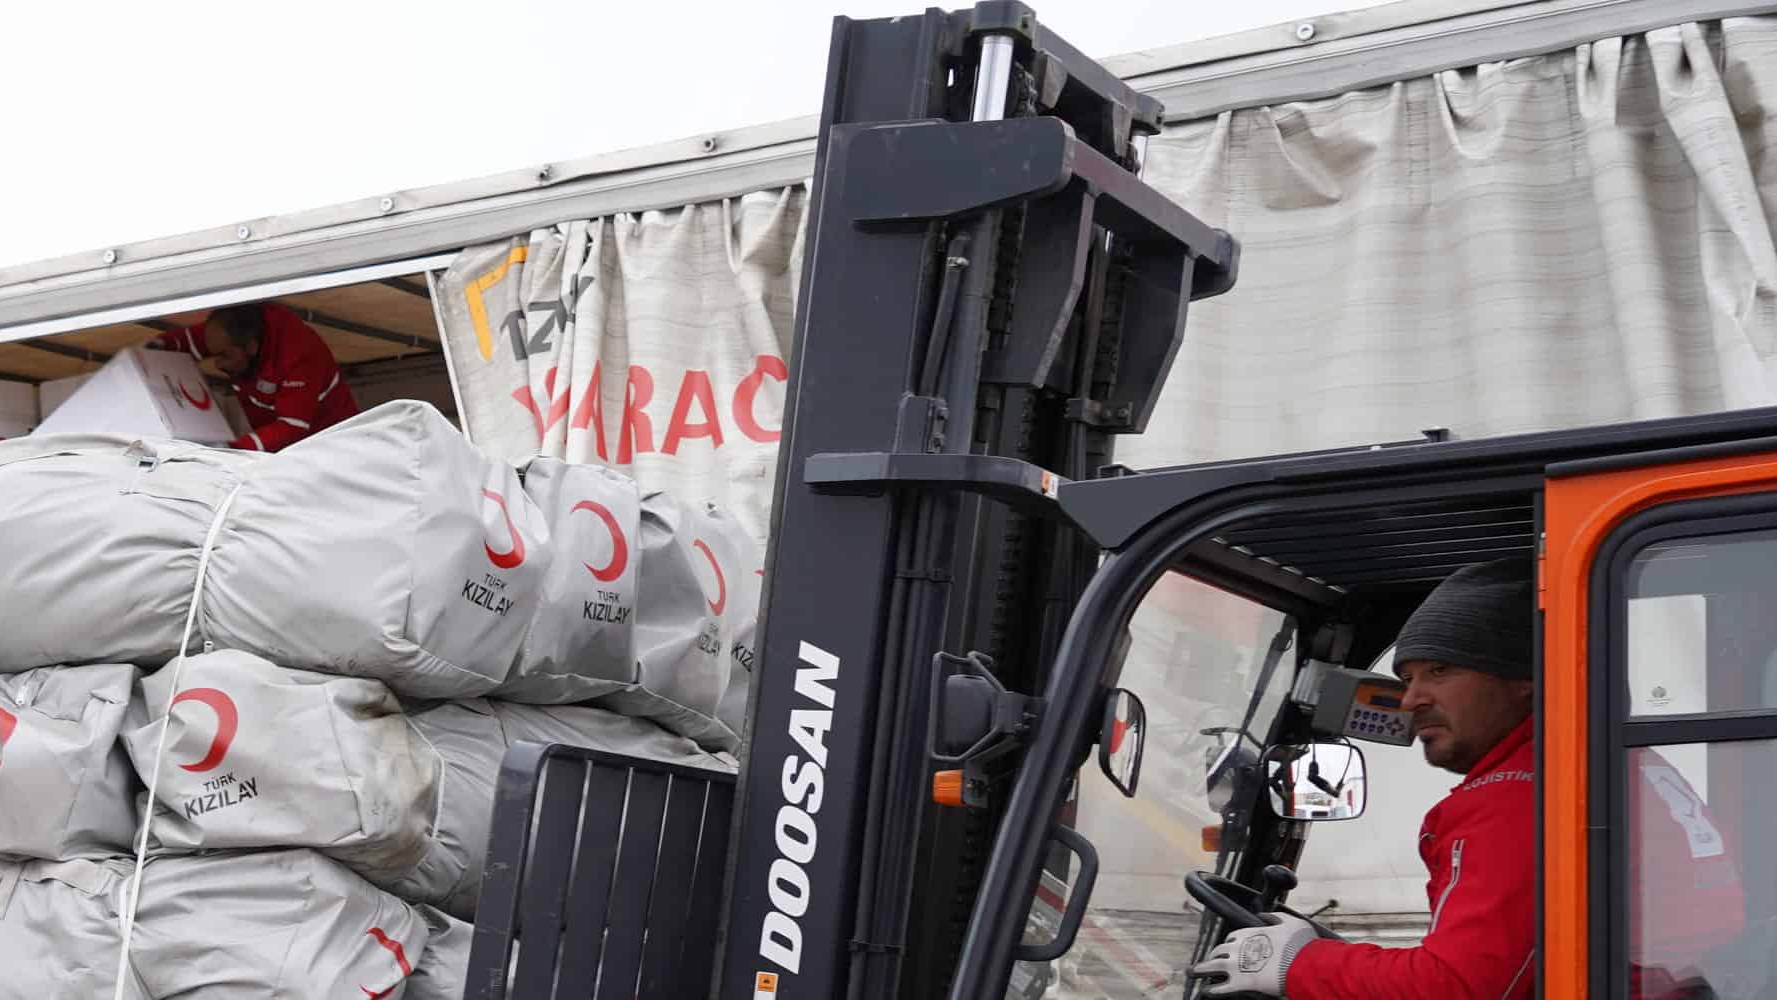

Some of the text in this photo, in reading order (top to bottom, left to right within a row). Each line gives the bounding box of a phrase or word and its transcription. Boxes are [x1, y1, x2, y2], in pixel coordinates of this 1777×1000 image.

[461, 578, 514, 617] KIZILAY
[582, 601, 630, 624] KIZILAY
[184, 775, 259, 820] KIZILAY
[759, 639, 840, 975] DOOSAN
